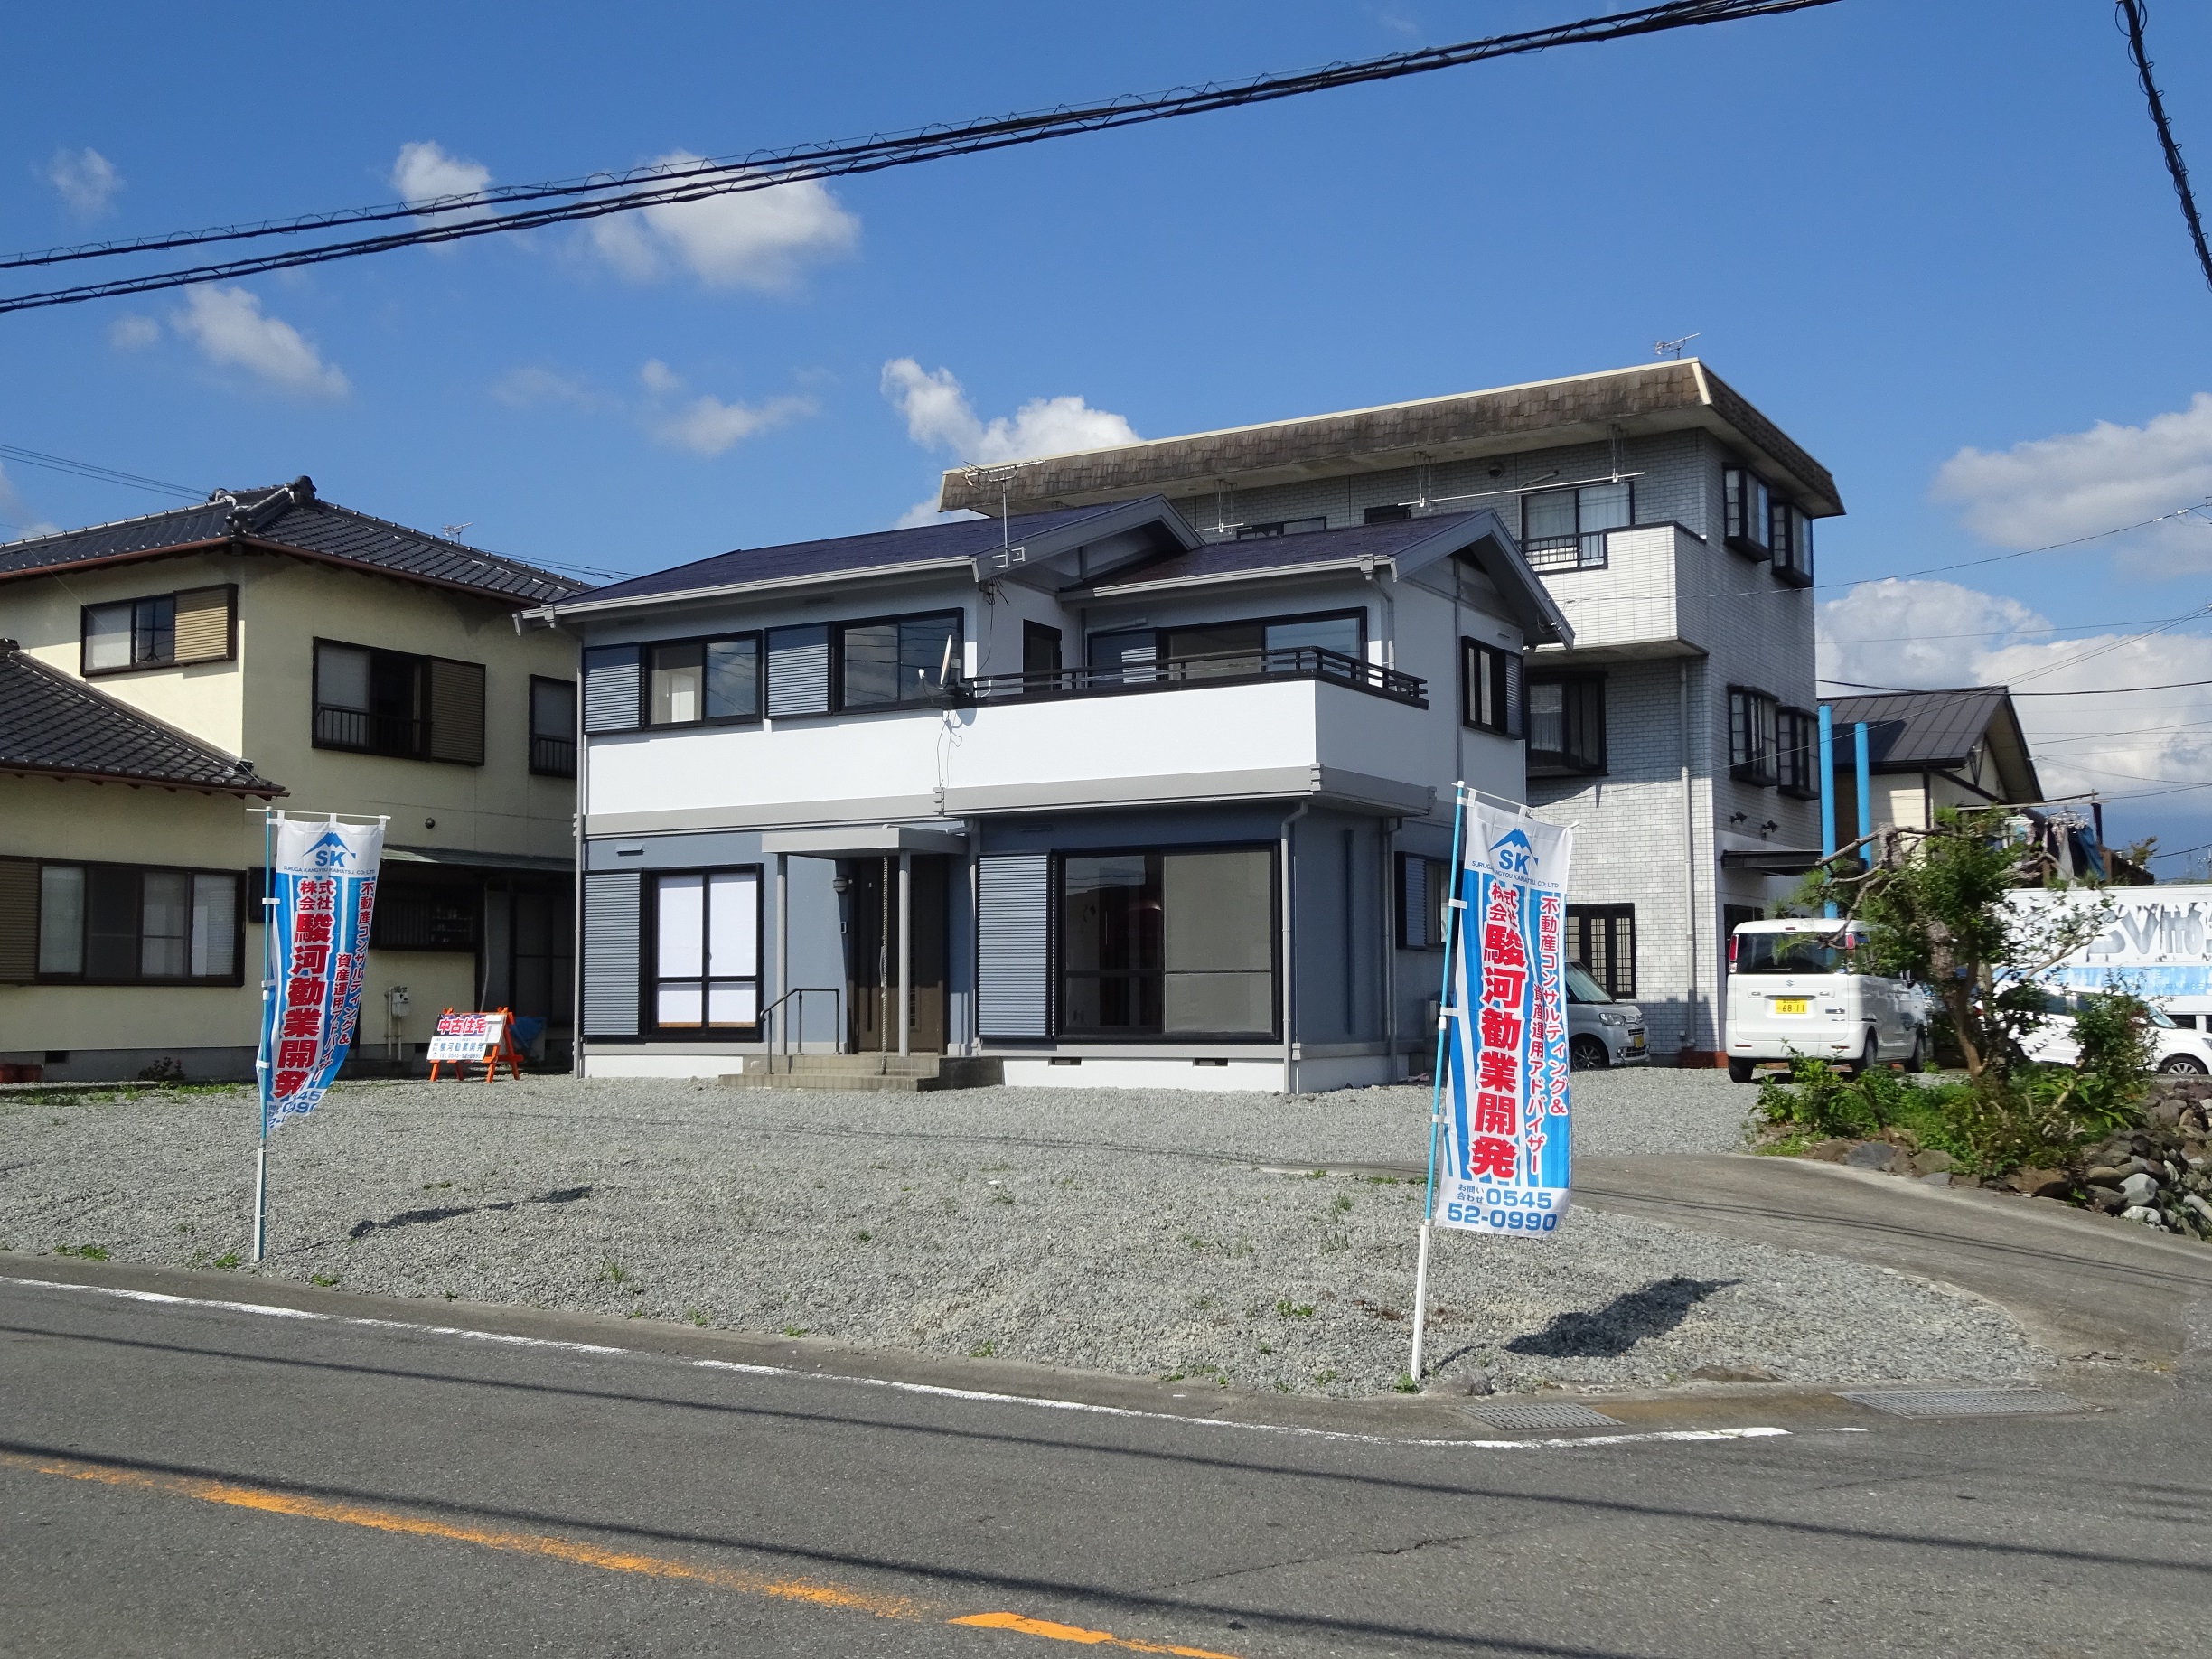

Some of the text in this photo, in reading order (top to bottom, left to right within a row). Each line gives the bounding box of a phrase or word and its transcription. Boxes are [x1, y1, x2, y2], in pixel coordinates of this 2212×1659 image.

[314, 850, 345, 867] SK
[1499, 849, 1530, 876] SK
[1782, 1004, 1805, 1012] 68-11
[1471, 923, 1527, 1179] 駿河勧業開発
[1486, 1188, 1552, 1209] 0545
[1448, 1203, 1558, 1231] 52-0990
